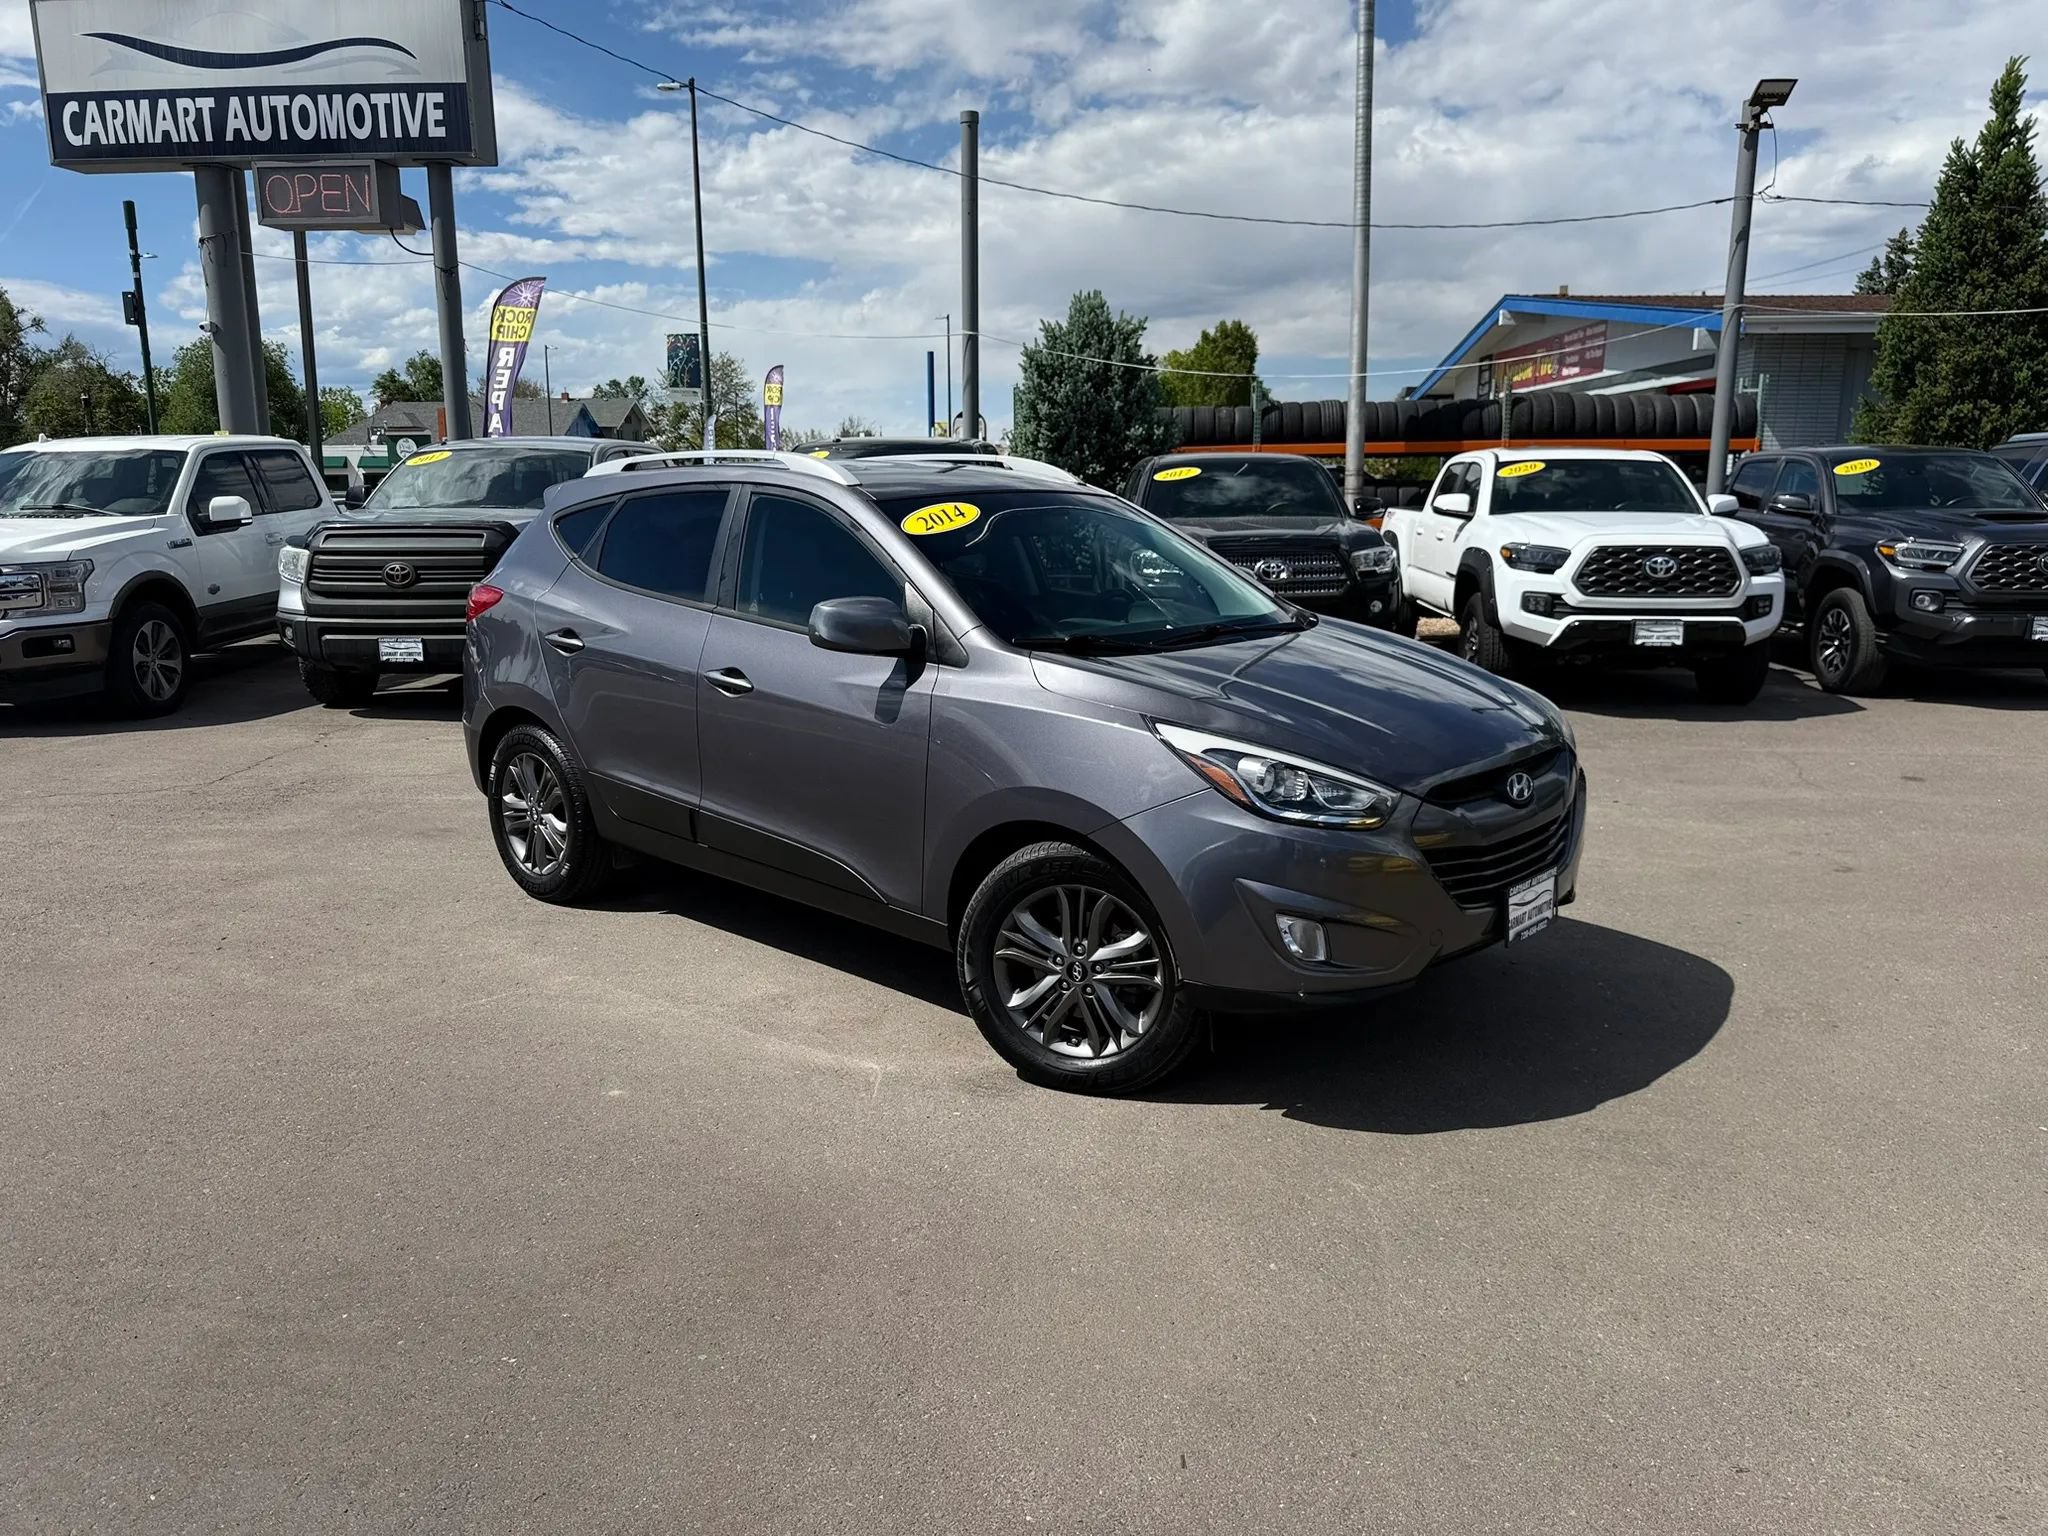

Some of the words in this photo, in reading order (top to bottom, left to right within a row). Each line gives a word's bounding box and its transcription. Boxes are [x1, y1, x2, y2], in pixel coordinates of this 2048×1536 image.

[62, 97, 216, 146] CARMART
[225, 92, 447, 142] AUTOMOTIVE
[265, 174, 371, 214] OPEN
[1507, 463, 1537, 475] 2020
[1843, 461, 1872, 473] 2020
[916, 504, 966, 532] 2014
